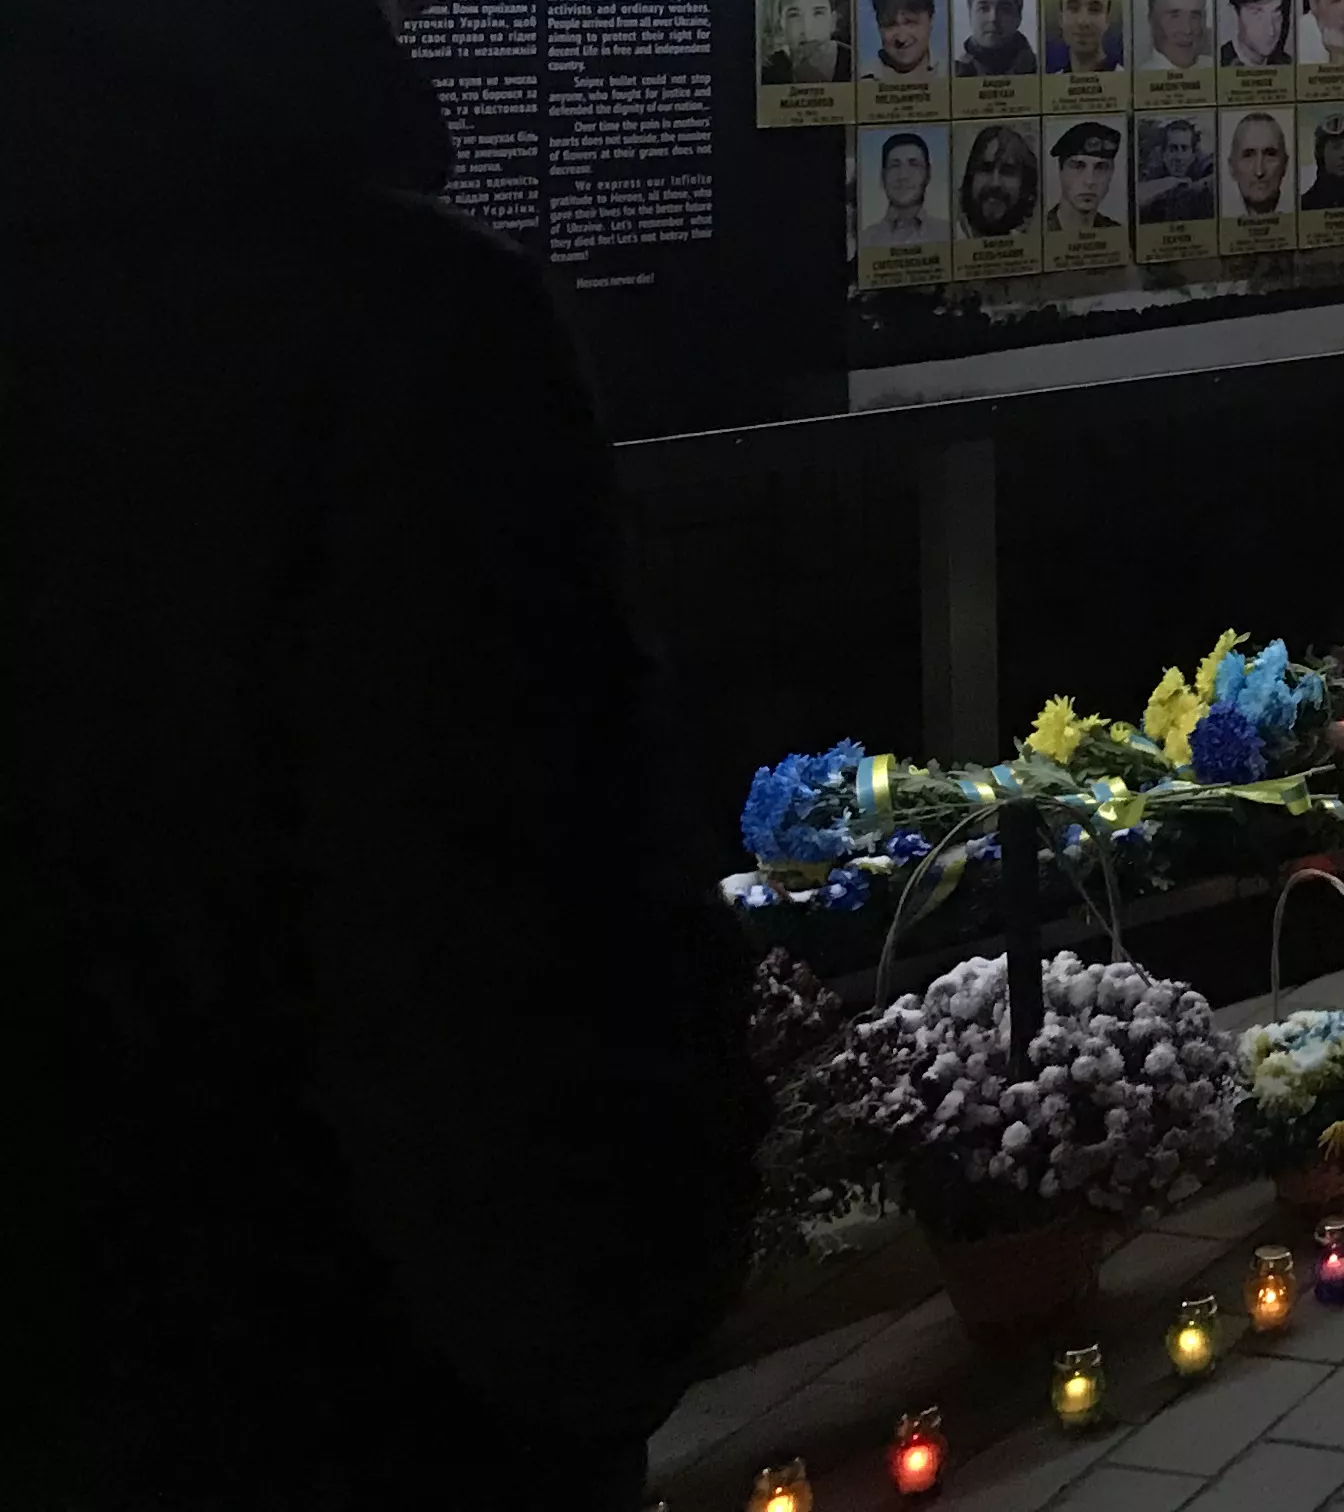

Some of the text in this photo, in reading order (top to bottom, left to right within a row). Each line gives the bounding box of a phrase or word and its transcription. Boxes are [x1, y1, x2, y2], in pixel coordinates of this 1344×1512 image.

[547, 4, 591, 15] activists
[597, 5, 616, 14] and
[621, 4, 664, 15] ordinary
[597, 179, 641, 190] express
